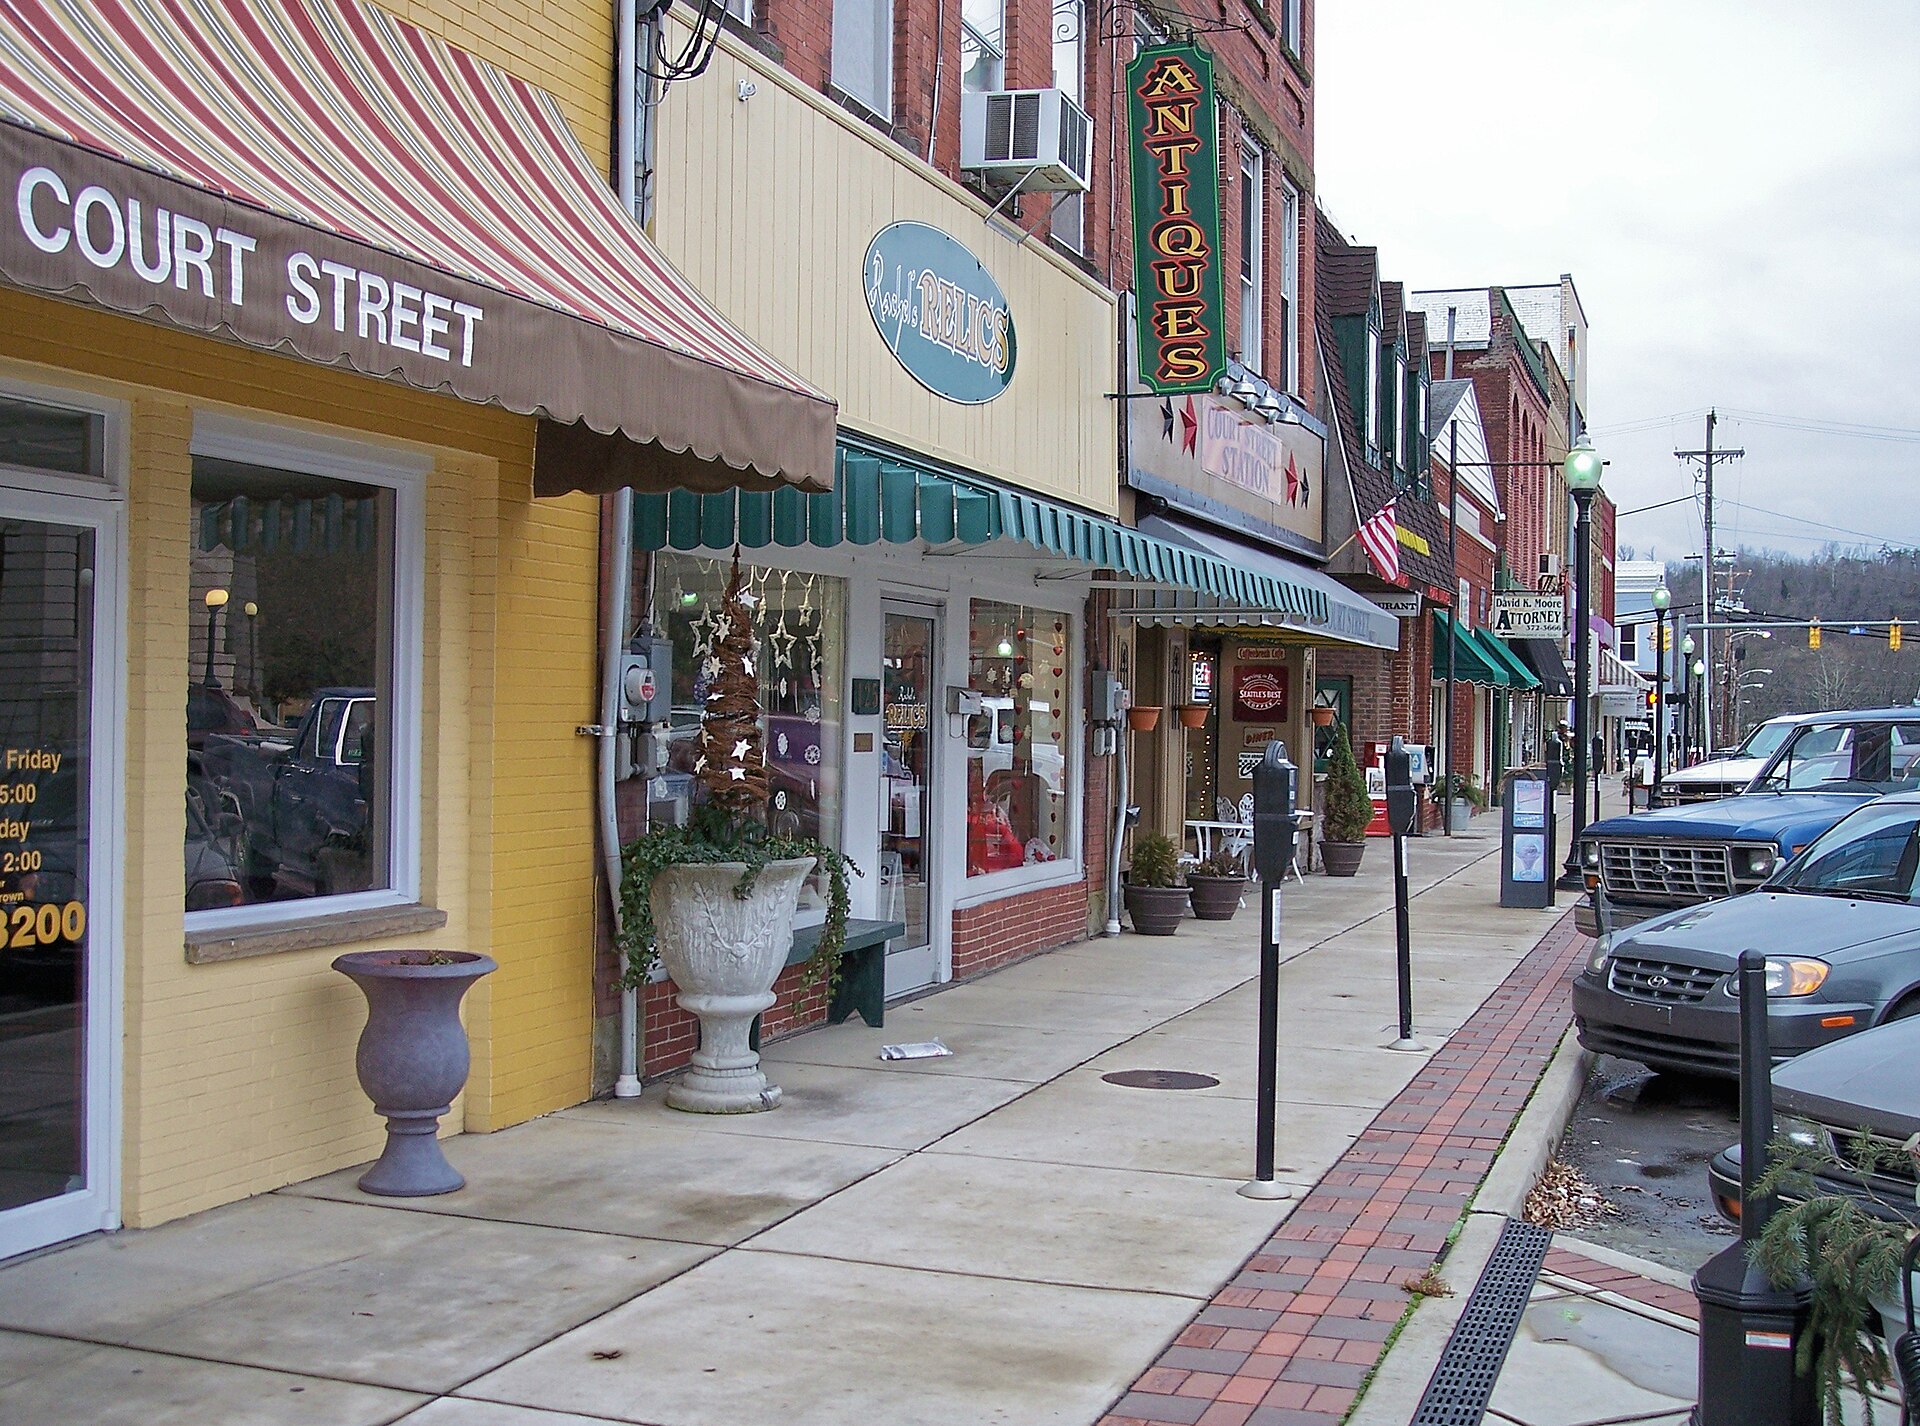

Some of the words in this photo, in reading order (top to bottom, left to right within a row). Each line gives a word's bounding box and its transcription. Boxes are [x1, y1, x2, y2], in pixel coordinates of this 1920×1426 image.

[1142, 60, 1208, 380] ANTIQUES
[17, 166, 257, 306] COURT
[286, 252, 484, 368] STREET
[917, 268, 1009, 376] RELICS
[1207, 407, 1240, 442] COURT
[1222, 445, 1270, 493] STATION
[1374, 602, 1417, 611] URANT
[1496, 598, 1520, 608] David
[1523, 599, 1532, 608] K.
[1535, 598, 1562, 608] Moore
[1495, 610, 1562, 630] ATTORNEY
[1239, 689, 1267, 699] SEATTLE'S
[1266, 690, 1282, 699] BEST
[1245, 730, 1275, 745] DINER
[6, 749, 62, 774] Friday
[0, 783, 37, 804] 5:00
[3, 850, 42, 872] 2:00
